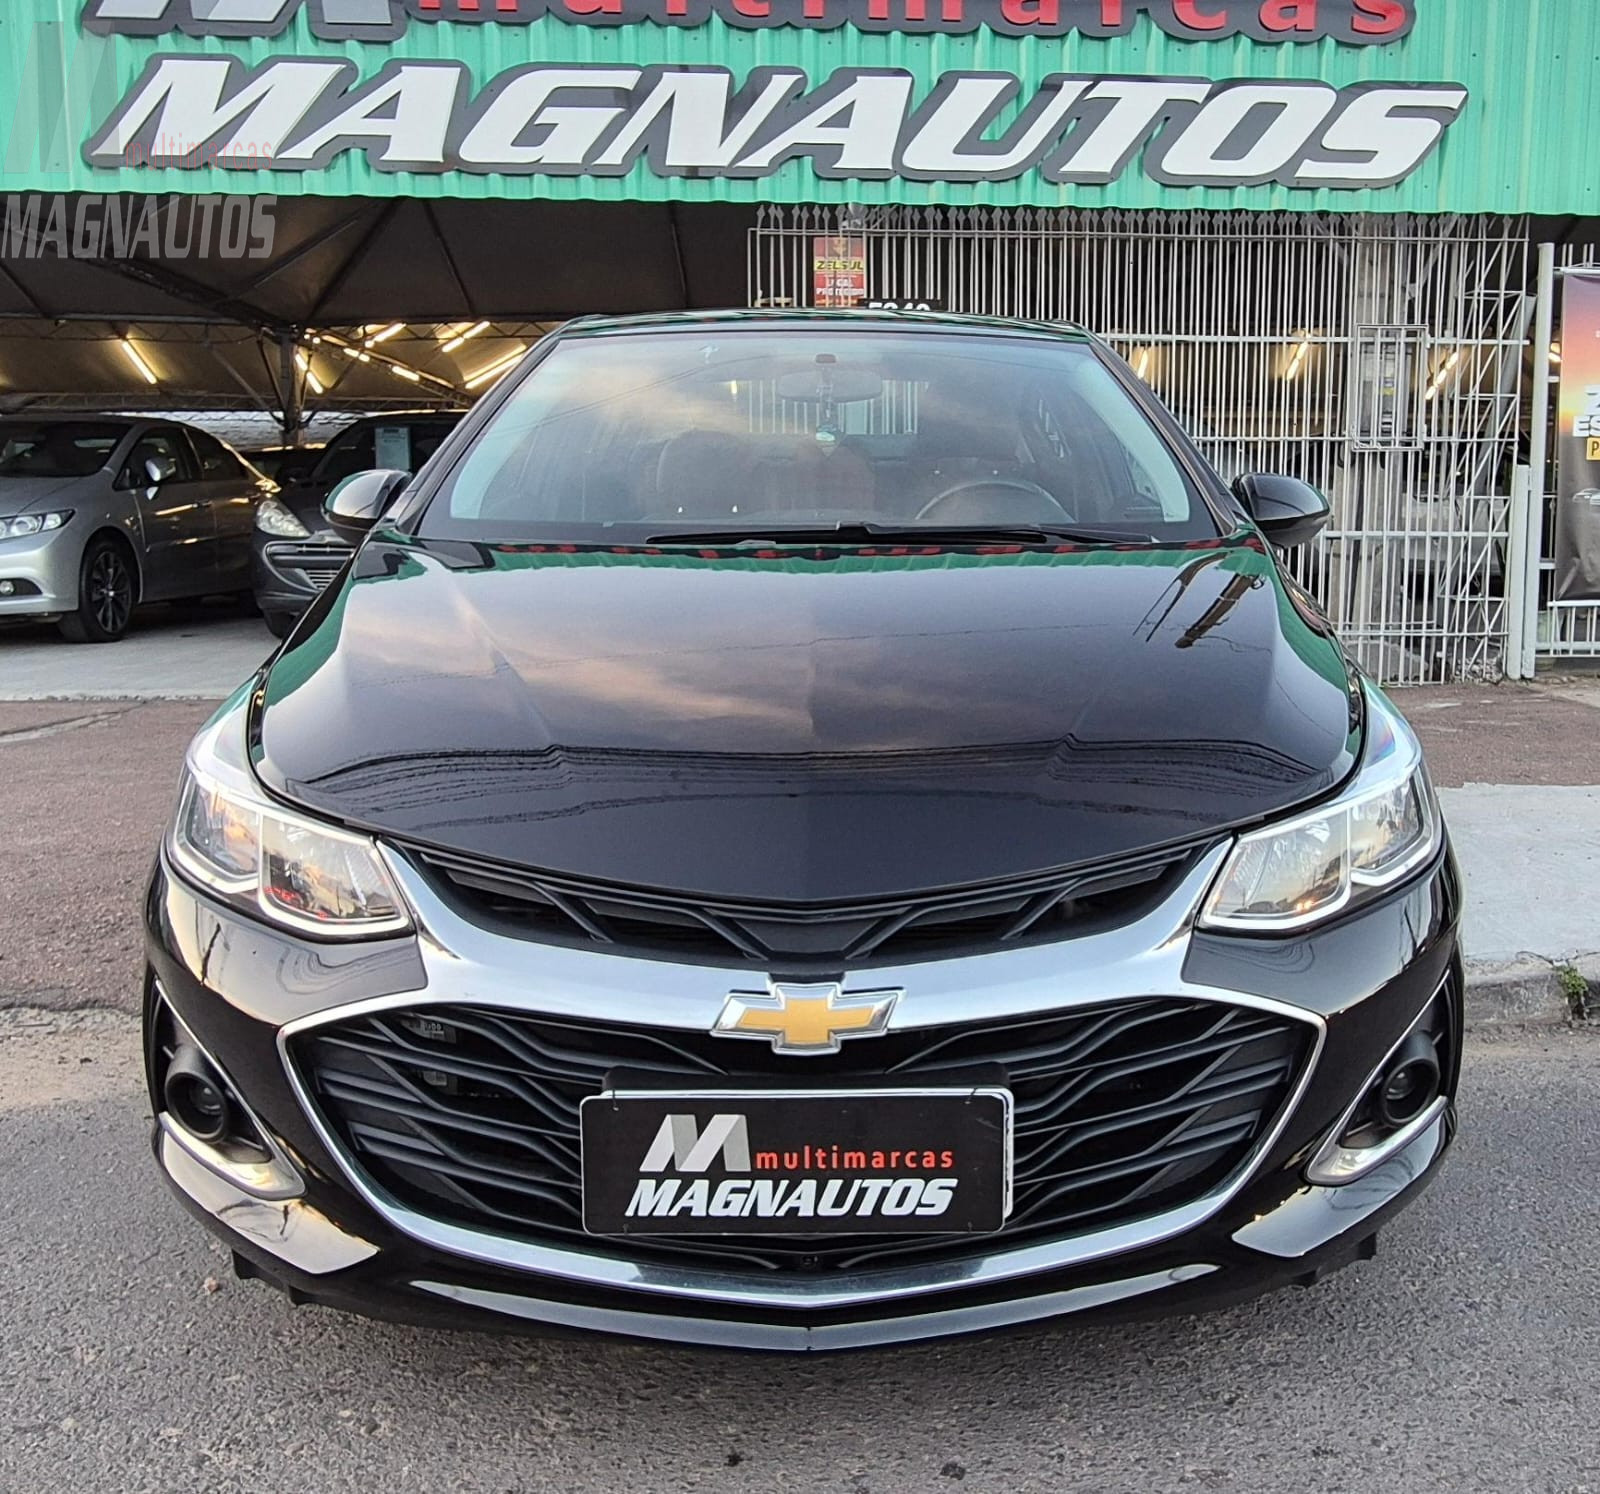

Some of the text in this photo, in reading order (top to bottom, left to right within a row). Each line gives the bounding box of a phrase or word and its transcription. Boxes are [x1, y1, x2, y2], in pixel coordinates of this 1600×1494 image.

[91, 58, 1467, 180] MAGNAUTOS
[756, 1145, 953, 1169] multimarcas
[624, 1178, 958, 1217] MAGNAUTOS
